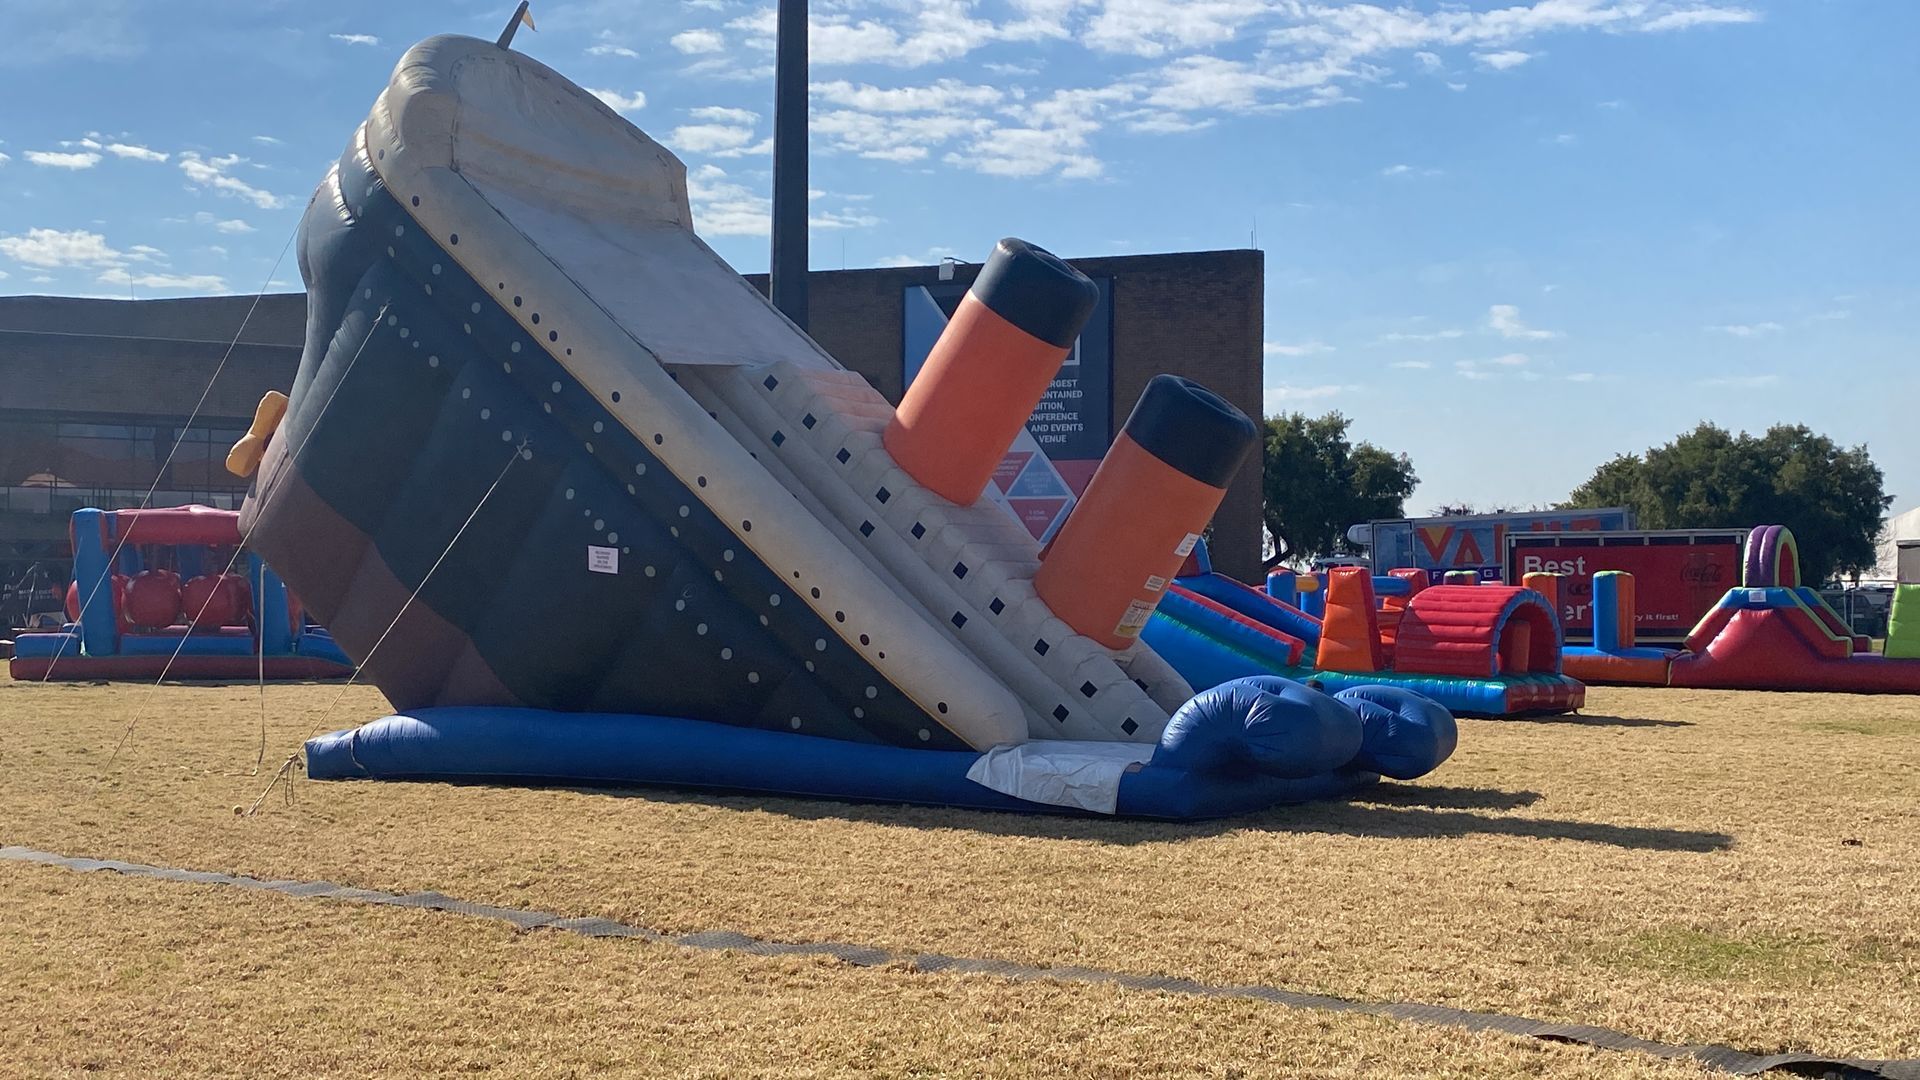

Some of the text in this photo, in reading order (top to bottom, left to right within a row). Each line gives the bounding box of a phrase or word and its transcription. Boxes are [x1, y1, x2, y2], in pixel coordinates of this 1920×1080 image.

[1048, 379, 1078, 388] RGEST
[1041, 390, 1083, 399] ONTAINED
[1028, 412, 1079, 421] ONFERENCE
[1031, 423, 1084, 432] AND EVENTS
[1039, 435, 1067, 443] VENUE
[1524, 556, 1586, 576] Best
